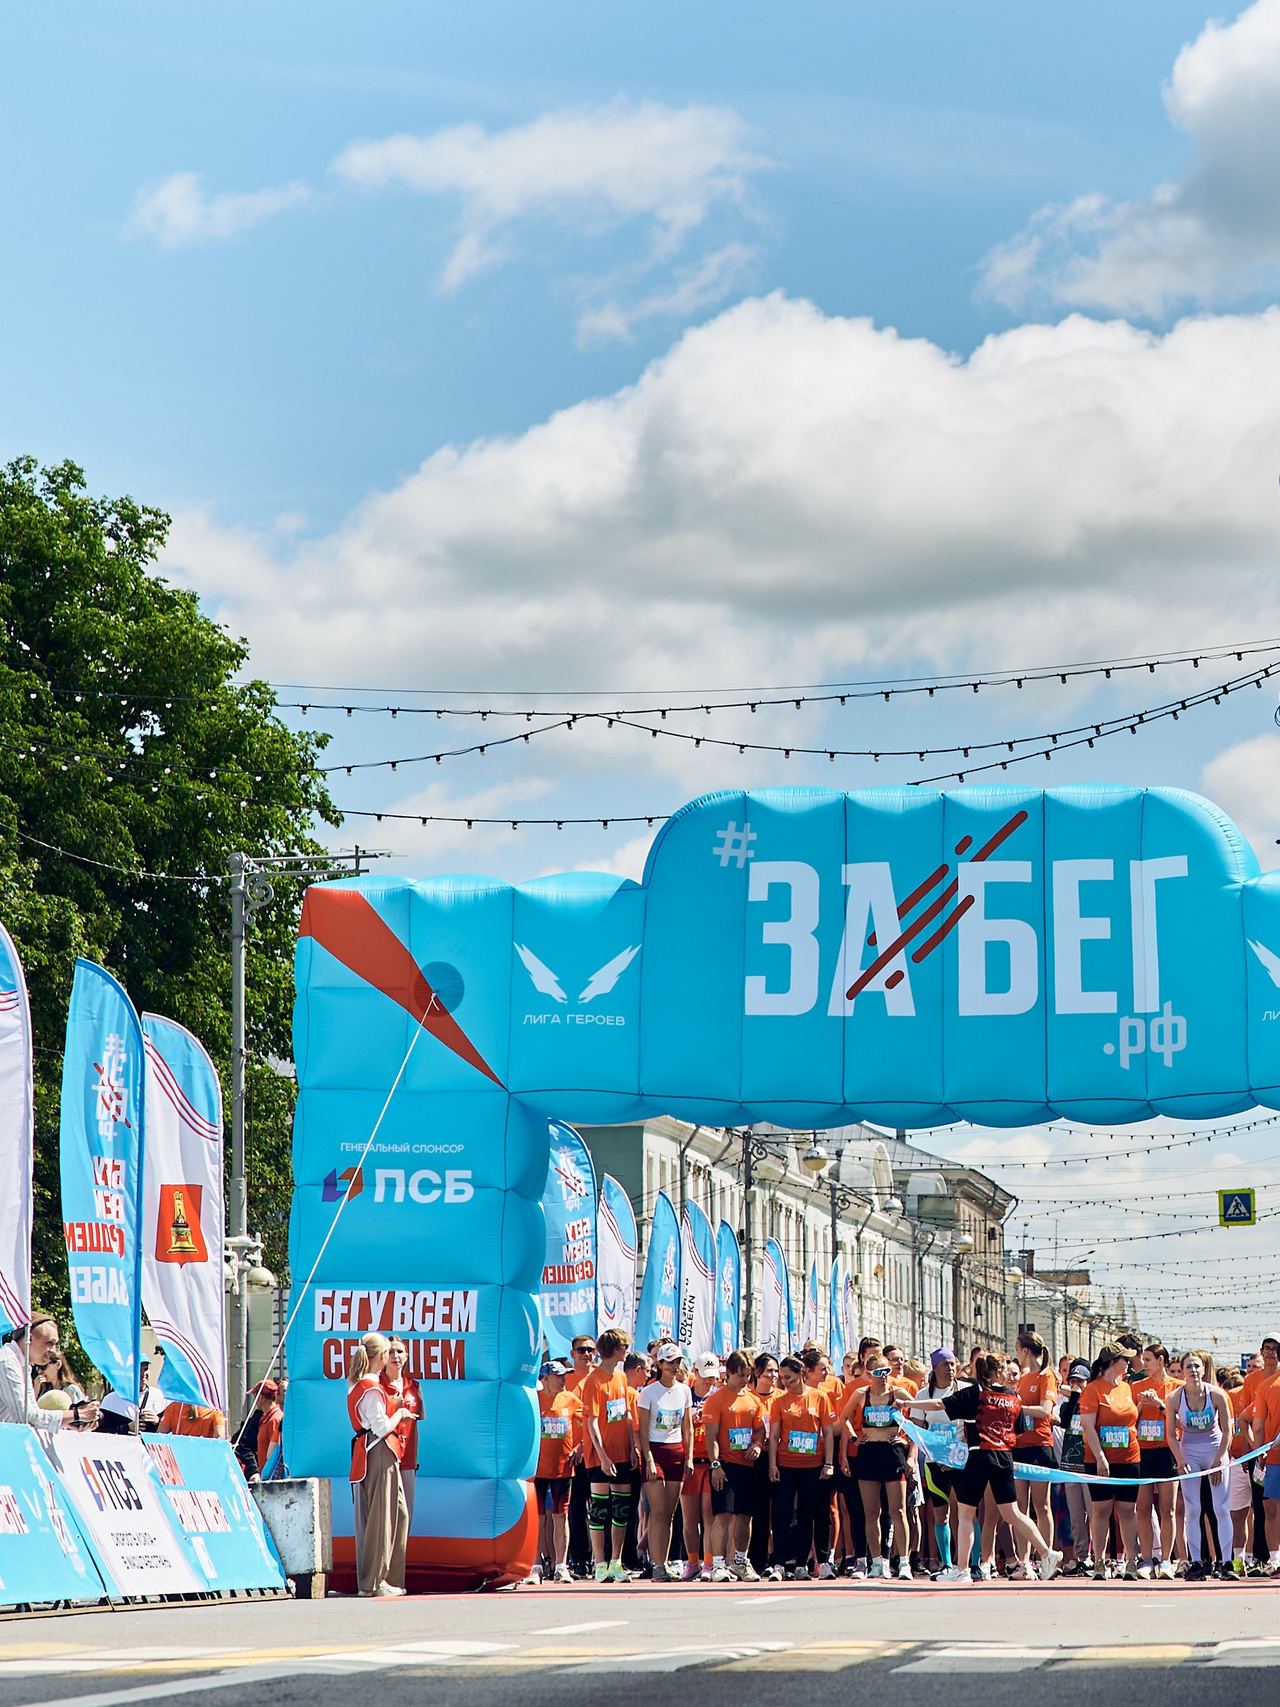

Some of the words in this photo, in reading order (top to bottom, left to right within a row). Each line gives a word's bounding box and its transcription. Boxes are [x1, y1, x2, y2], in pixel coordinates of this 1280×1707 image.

[523, 1014, 562, 1025] ЛИГА
[566, 1014, 626, 1026] ГЕРОЕВ
[340, 1142, 411, 1153] ГЕНЕРАЛЬНЫЙ
[412, 1144, 465, 1154] СПОНСОР
[373, 1168, 475, 1204] ПСБ
[314, 1289, 389, 1332] БЕГУ
[391, 1289, 478, 1332] ВСЕМ
[323, 1338, 465, 1380] СЕЦЕМ
[988, 1397, 1015, 1408] СУДЬЯ
[92, 1459, 143, 1511] ПСБ
